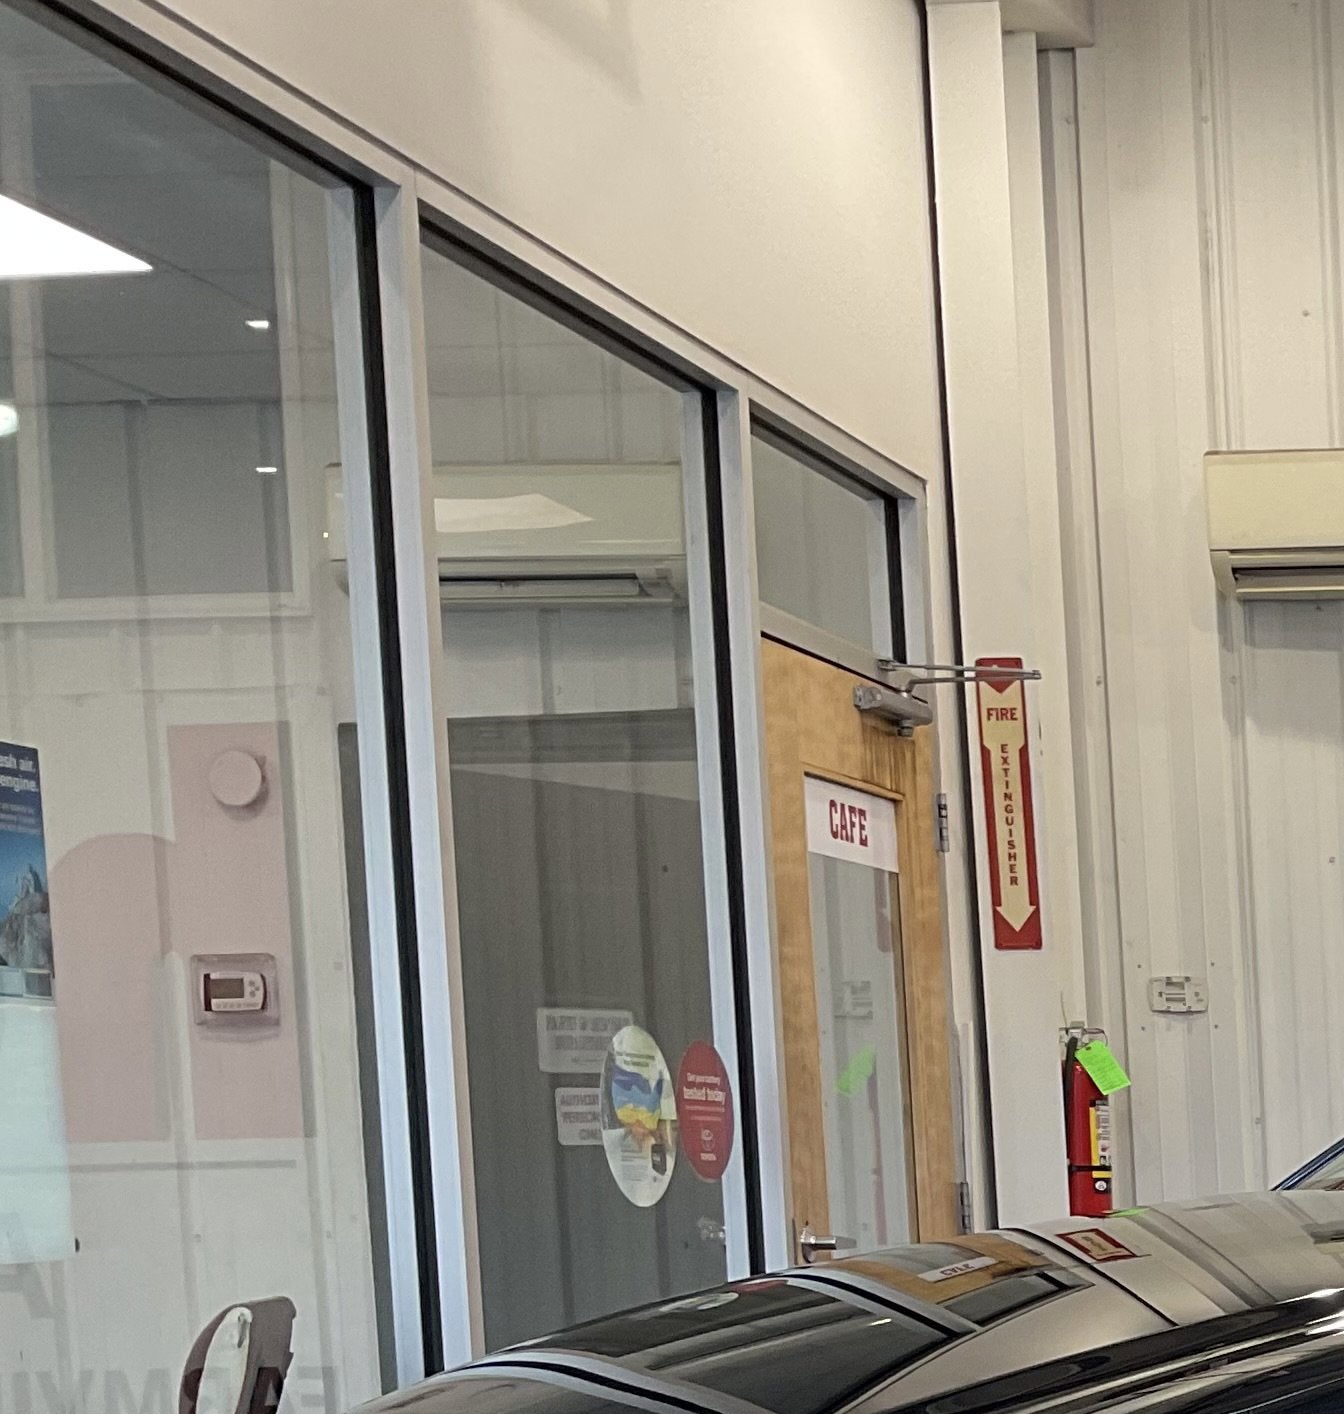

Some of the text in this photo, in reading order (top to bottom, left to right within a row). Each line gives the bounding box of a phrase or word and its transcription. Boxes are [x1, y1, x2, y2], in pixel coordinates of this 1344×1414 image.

[986, 707, 1018, 722] FIRE
[829, 799, 869, 848] CAFE
[1000, 743, 1019, 886] EXTINGUISHER
[683, 1086, 726, 1106] tested today
